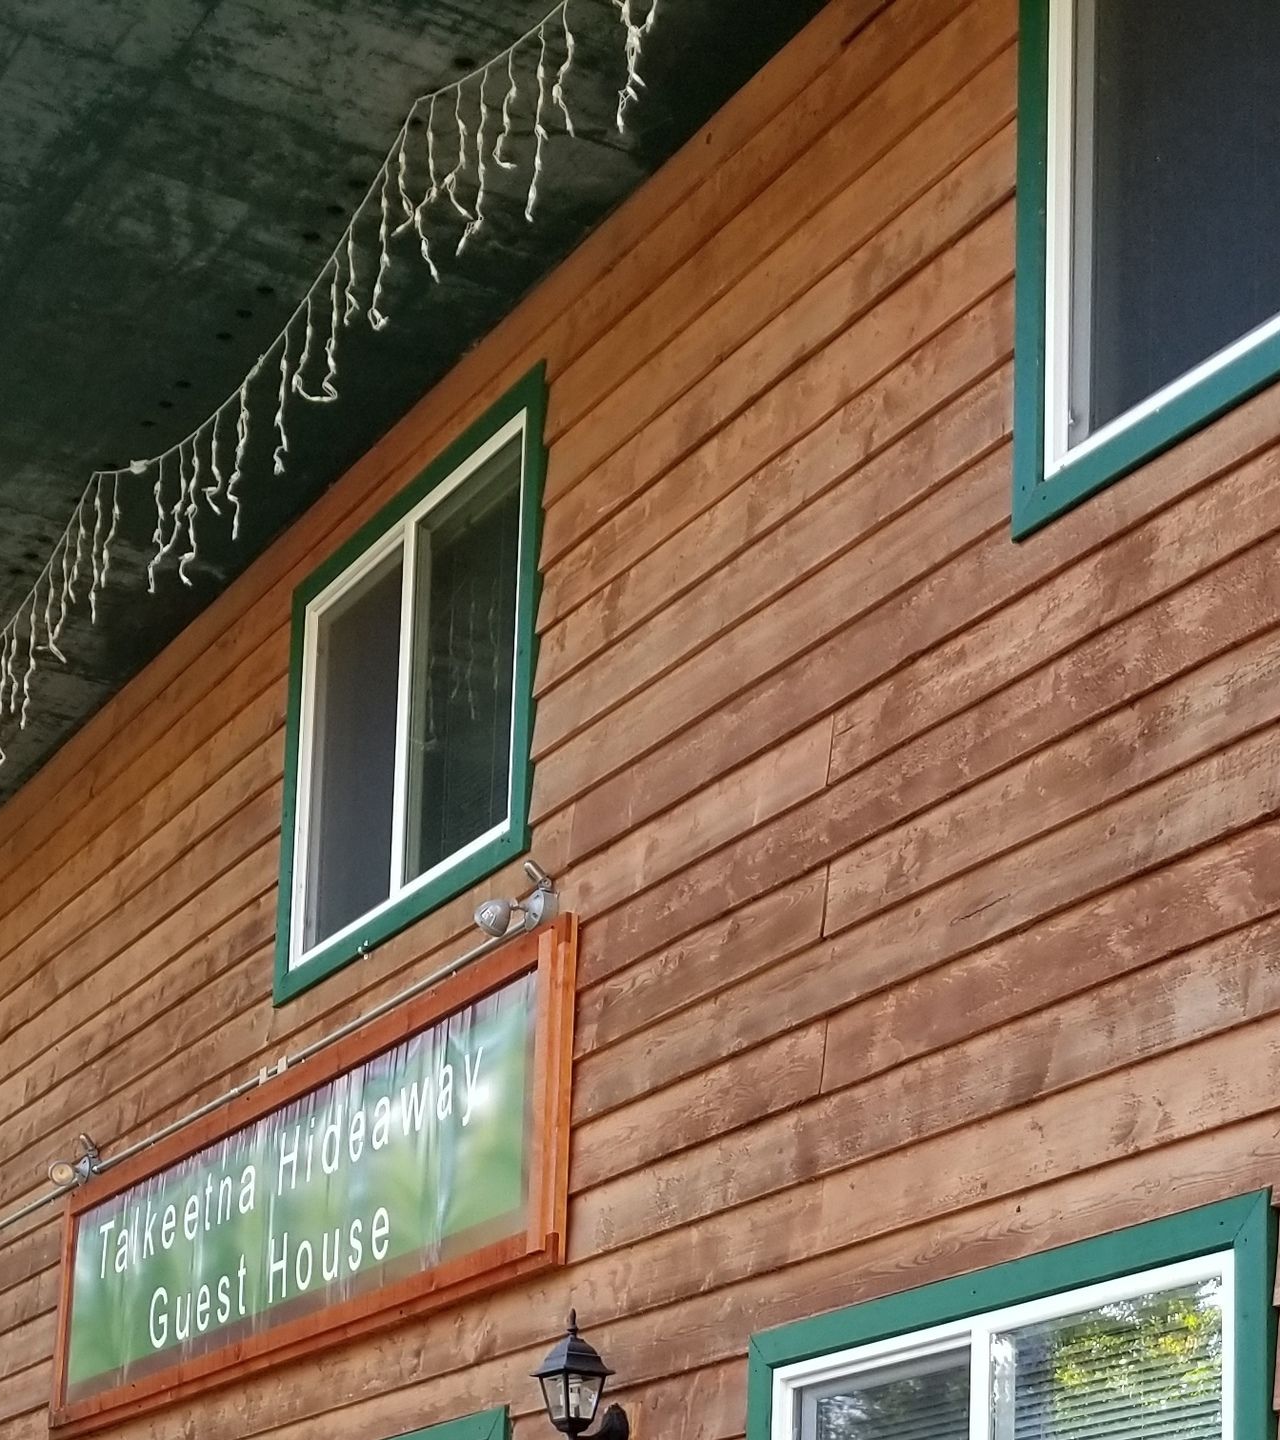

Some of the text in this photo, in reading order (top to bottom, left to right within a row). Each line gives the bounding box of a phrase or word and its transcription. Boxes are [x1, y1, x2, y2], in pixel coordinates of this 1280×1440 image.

[98, 1047, 485, 1279] Talkeetna Hideaway
[148, 1206, 391, 1349] Guest House
